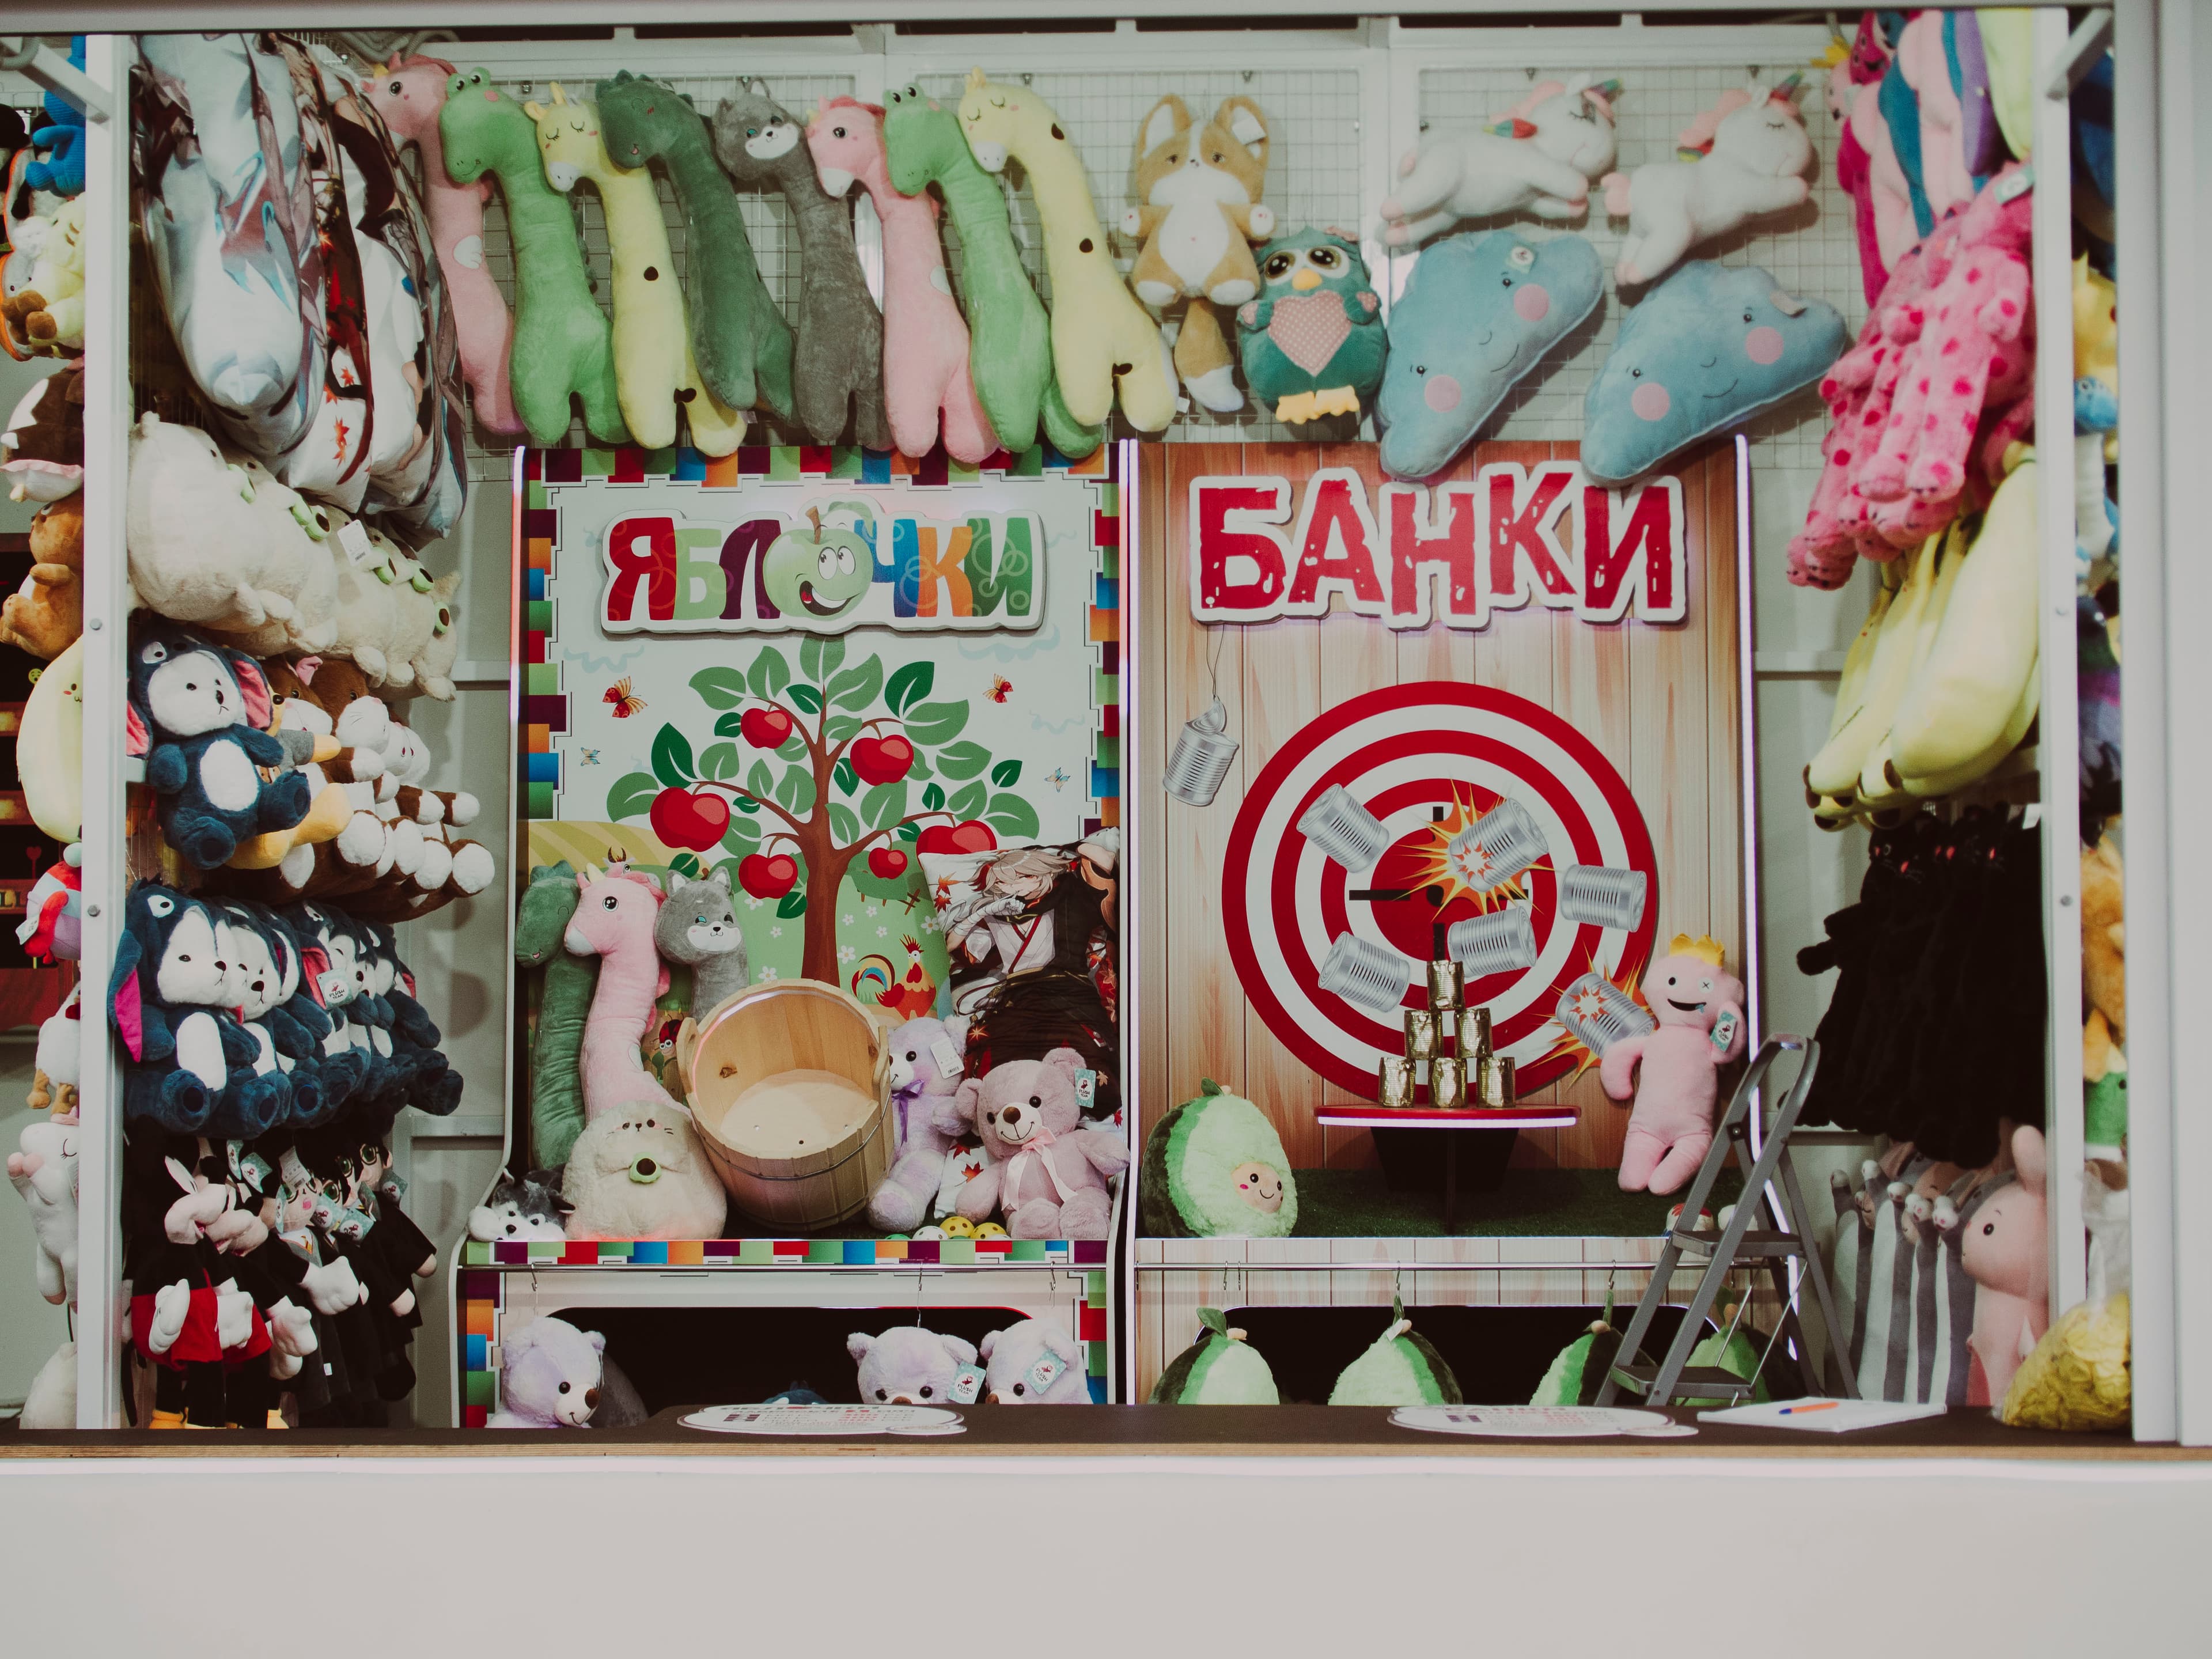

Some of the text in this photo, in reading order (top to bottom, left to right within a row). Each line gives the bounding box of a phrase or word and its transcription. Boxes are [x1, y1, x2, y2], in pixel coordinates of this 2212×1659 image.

[607, 516, 1034, 621] ЯБЛОЧКИ
[1199, 472, 1674, 616] БАНКИ
[329, 988, 345, 997] PLUSH
[957, 1383, 973, 1393] PLUSH
